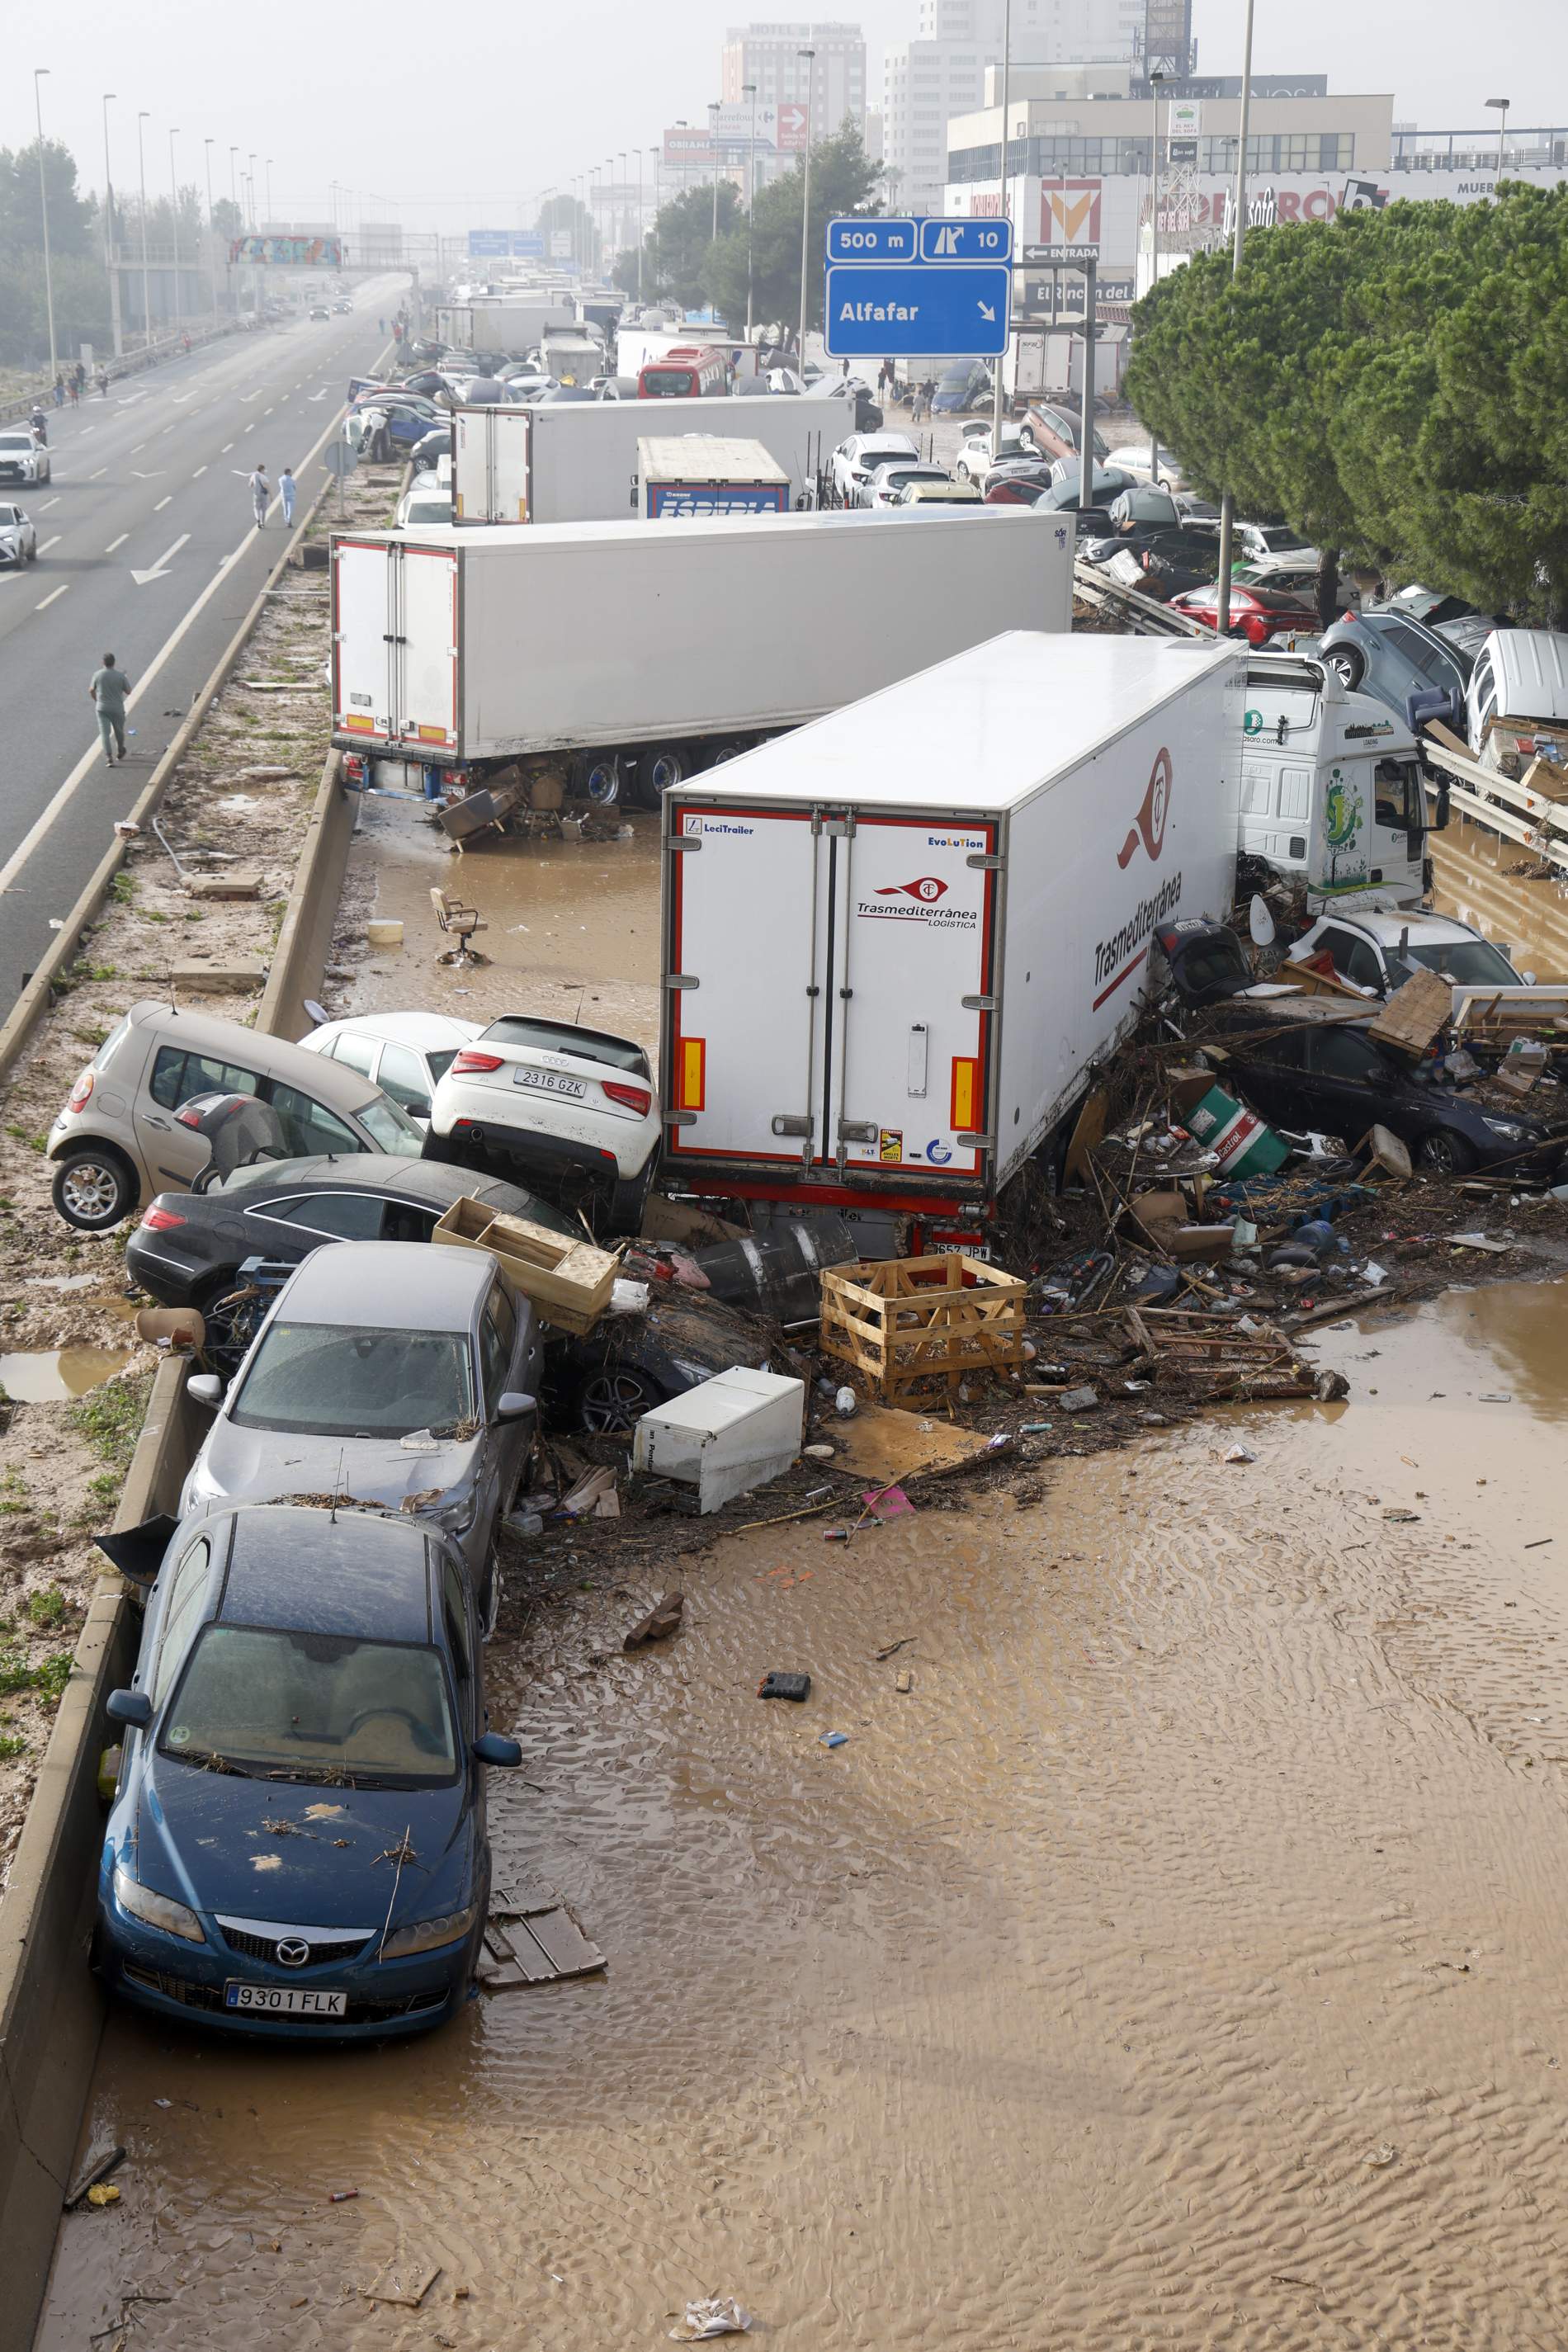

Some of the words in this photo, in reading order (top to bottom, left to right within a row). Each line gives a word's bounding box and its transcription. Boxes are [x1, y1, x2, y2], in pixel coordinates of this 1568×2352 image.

[840, 233, 877, 248] 500
[888, 236, 904, 248] m
[978, 232, 999, 248] 10
[1051, 248, 1098, 258] ENTRADA
[1106, 286, 1128, 300] del
[839, 302, 919, 321] Alfafar
[704, 824, 754, 835] LeciTrailer
[857, 903, 977, 919] Trasmediterránea
[522, 1072, 555, 1087] 2316
[558, 1079, 583, 1094] GZK
[1217, 1131, 1242, 1158] Castrol
[966, 1246, 987, 1259] JPW
[240, 1988, 294, 2009] 9301
[301, 1993, 342, 2013] FLK
